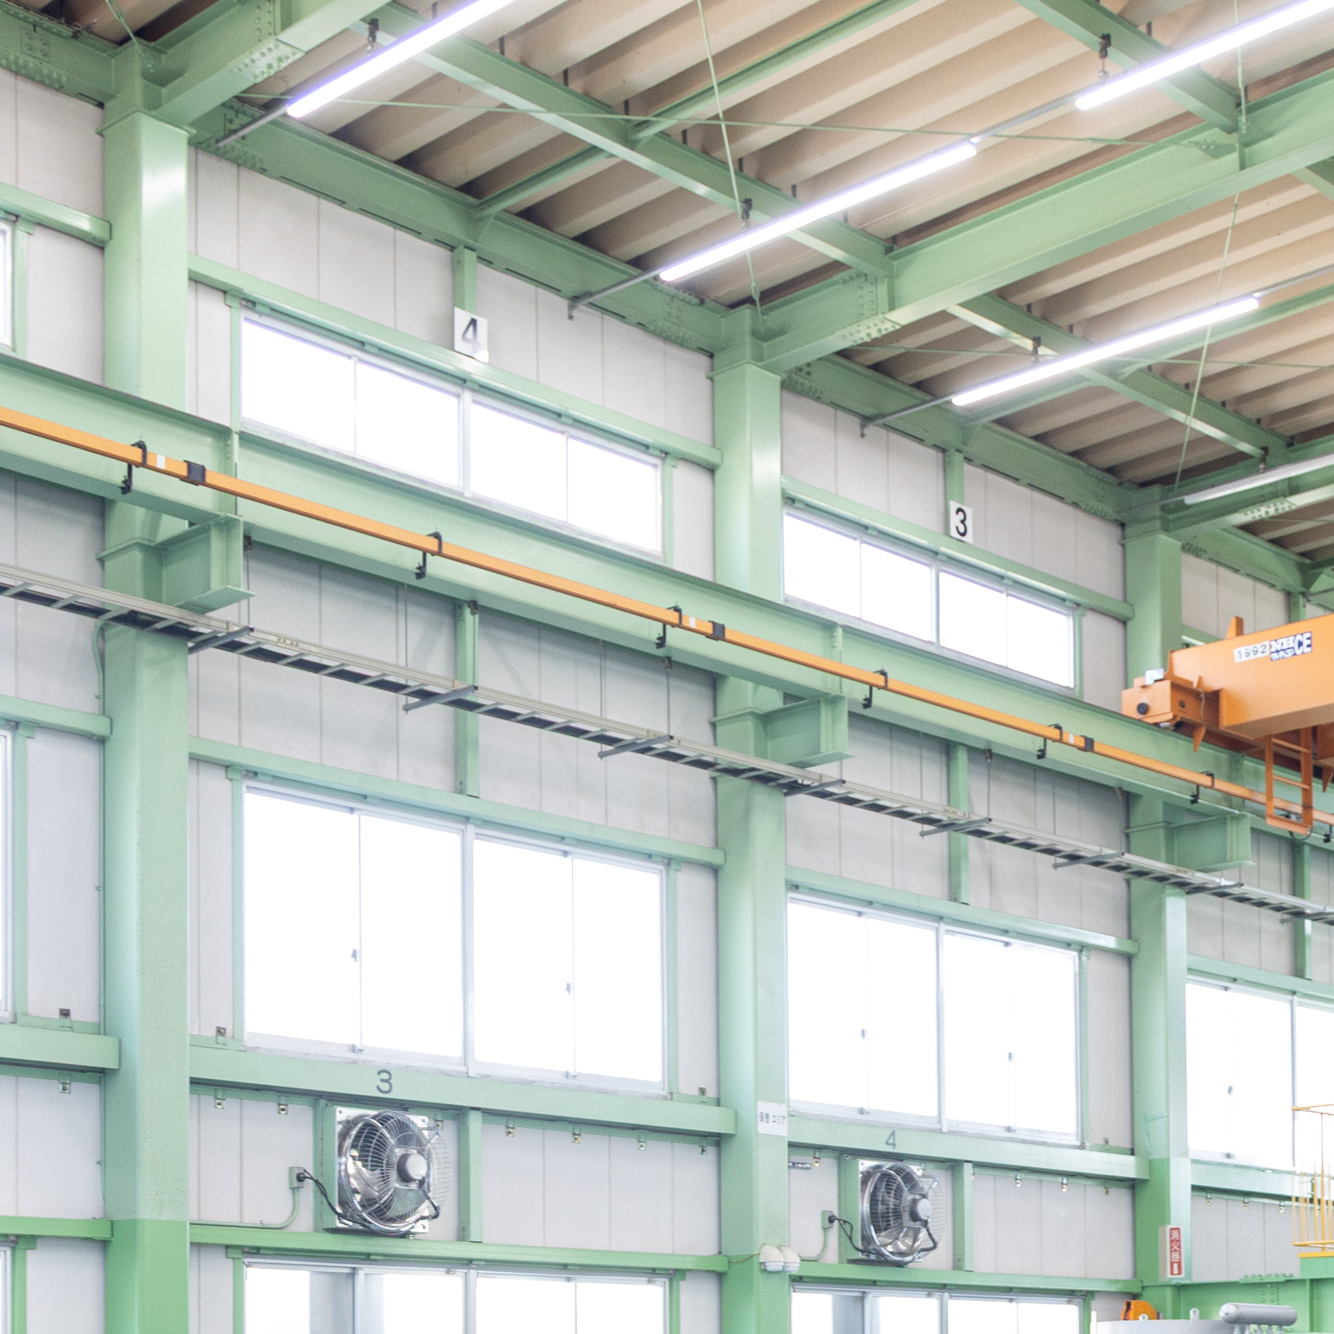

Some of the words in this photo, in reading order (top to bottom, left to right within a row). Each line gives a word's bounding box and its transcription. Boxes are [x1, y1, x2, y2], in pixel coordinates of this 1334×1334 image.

[462, 318, 481, 354] 4
[956, 507, 967, 537] 3
[376, 1069, 393, 1094] 3
[885, 1130, 897, 1150] 4
[1170, 1229, 1181, 1263] 消火器
